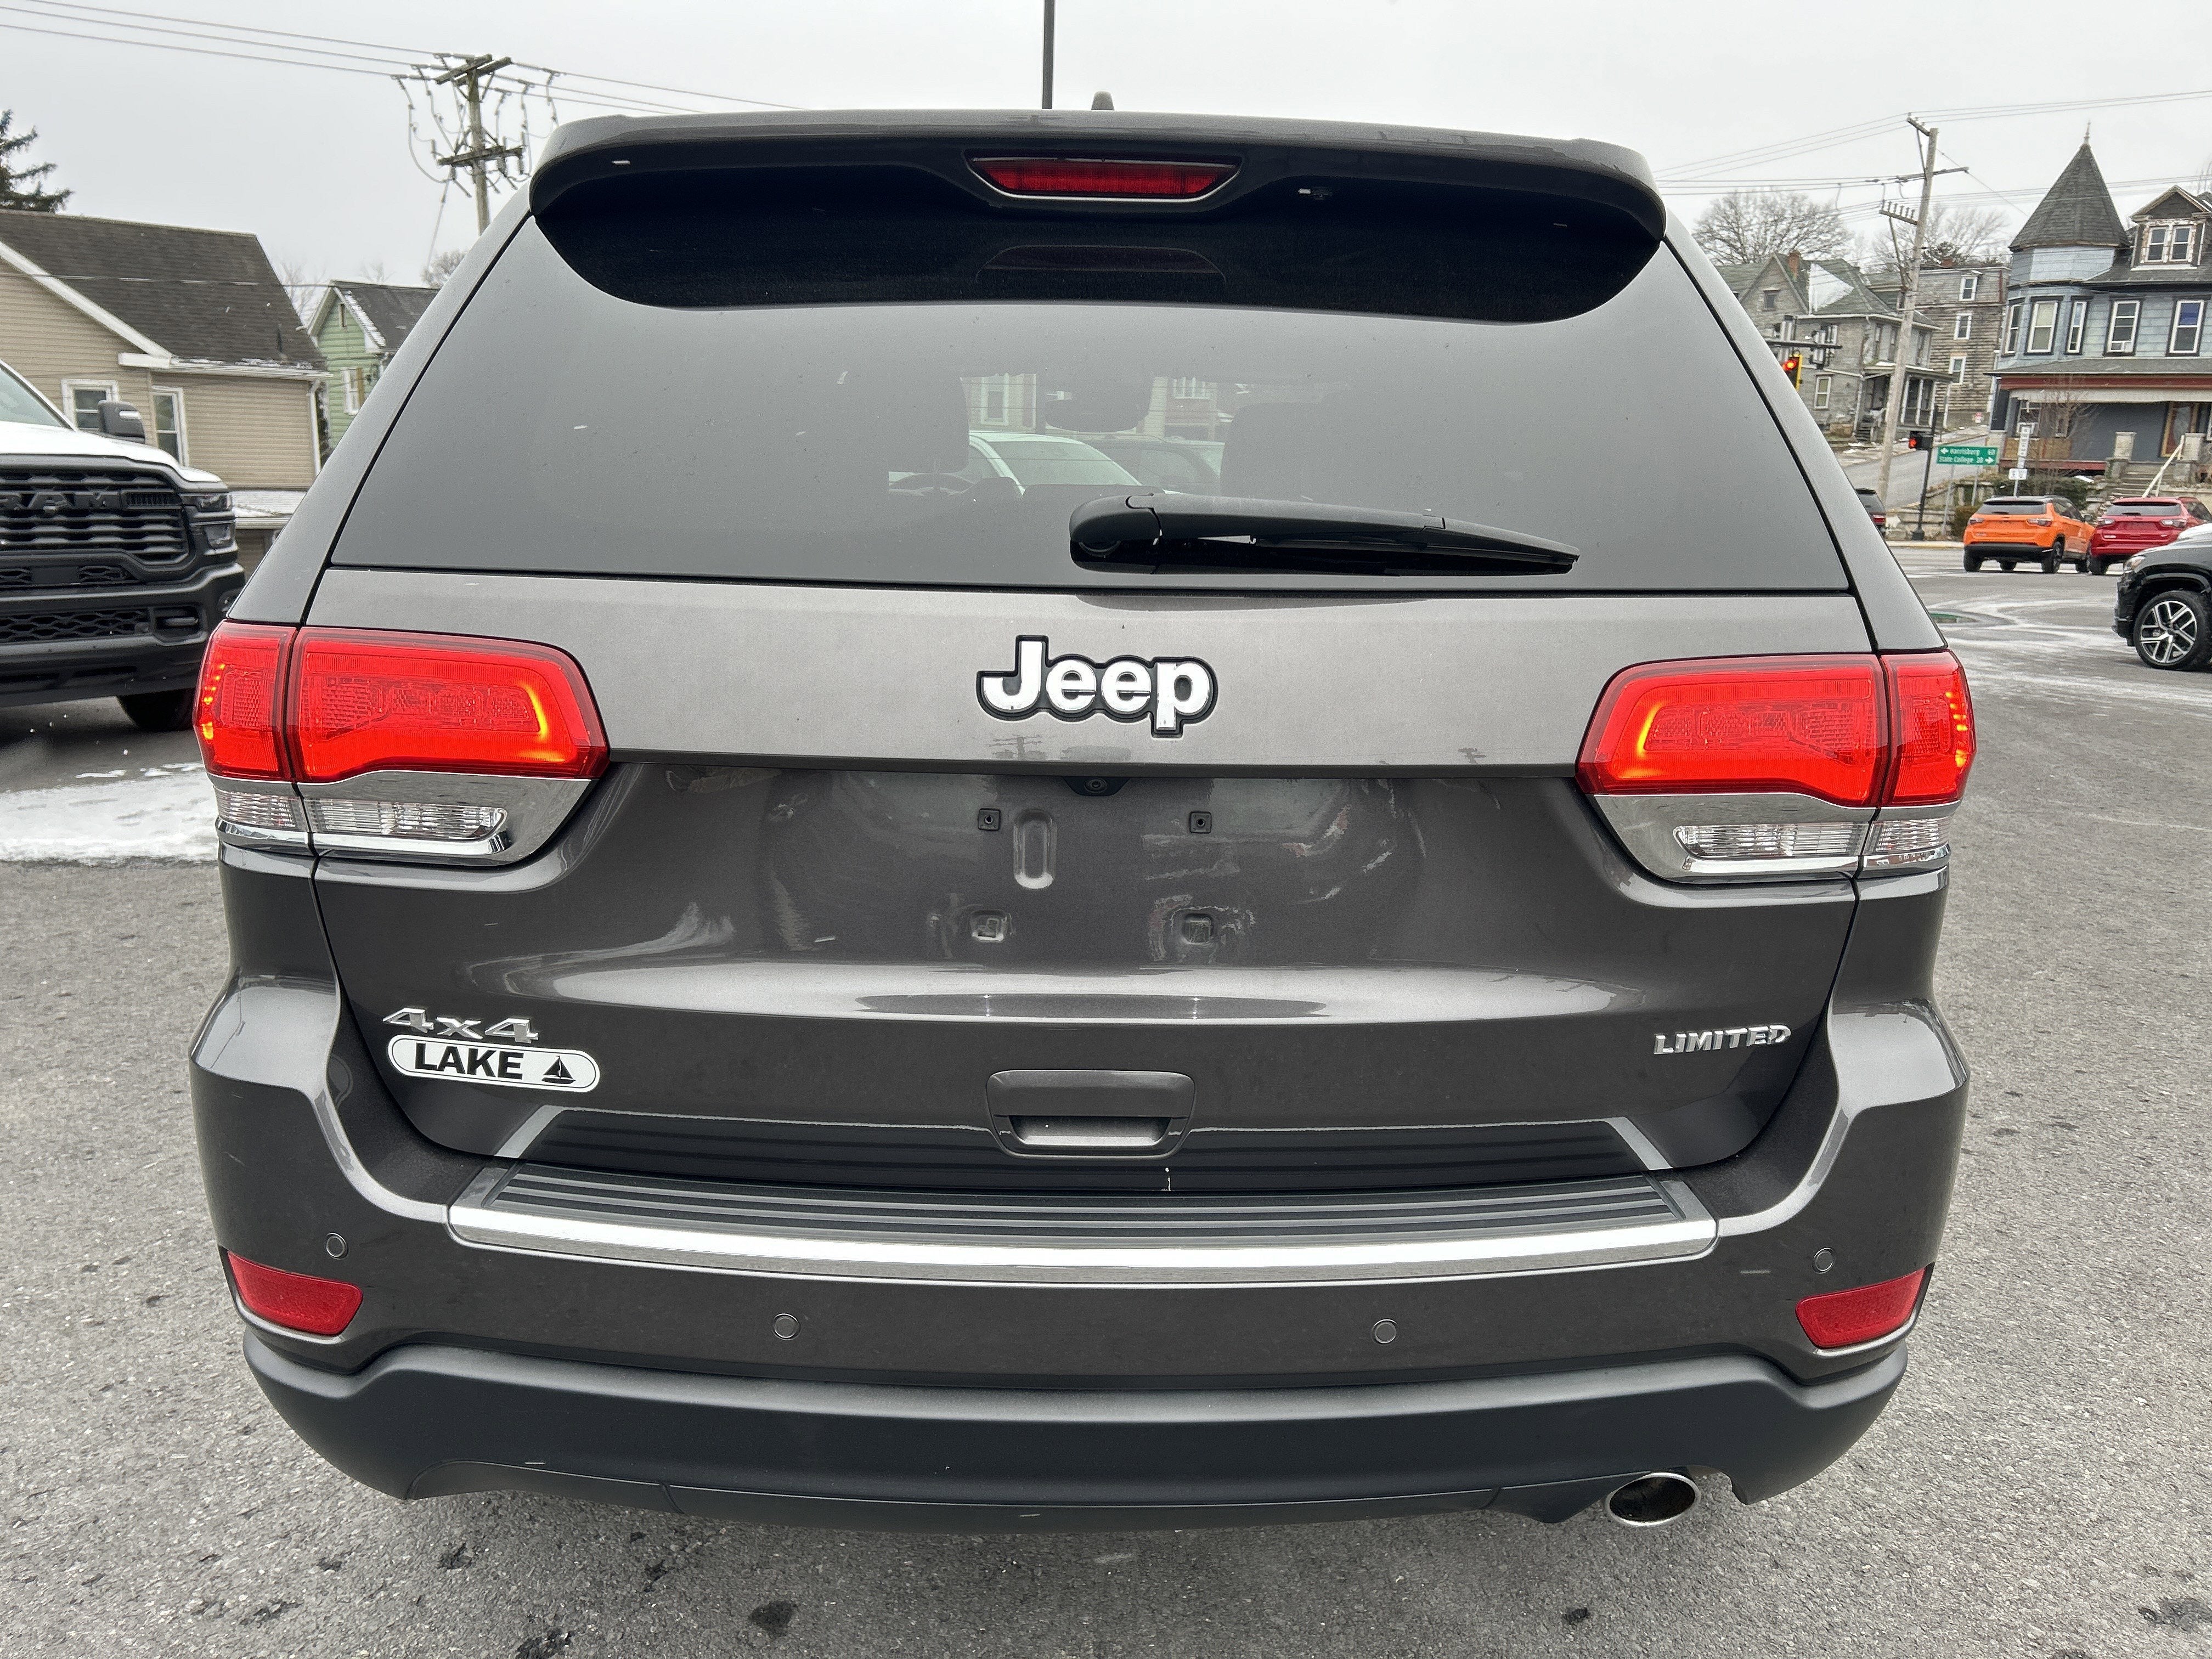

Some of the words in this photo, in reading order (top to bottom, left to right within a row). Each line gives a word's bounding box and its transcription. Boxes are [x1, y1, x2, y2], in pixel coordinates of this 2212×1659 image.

[1954, 456, 1974, 464] College
[980, 639, 1212, 732] Jeep
[1654, 1024, 1791, 1055] LIMITED
[414, 1042, 524, 1080] LAKE
